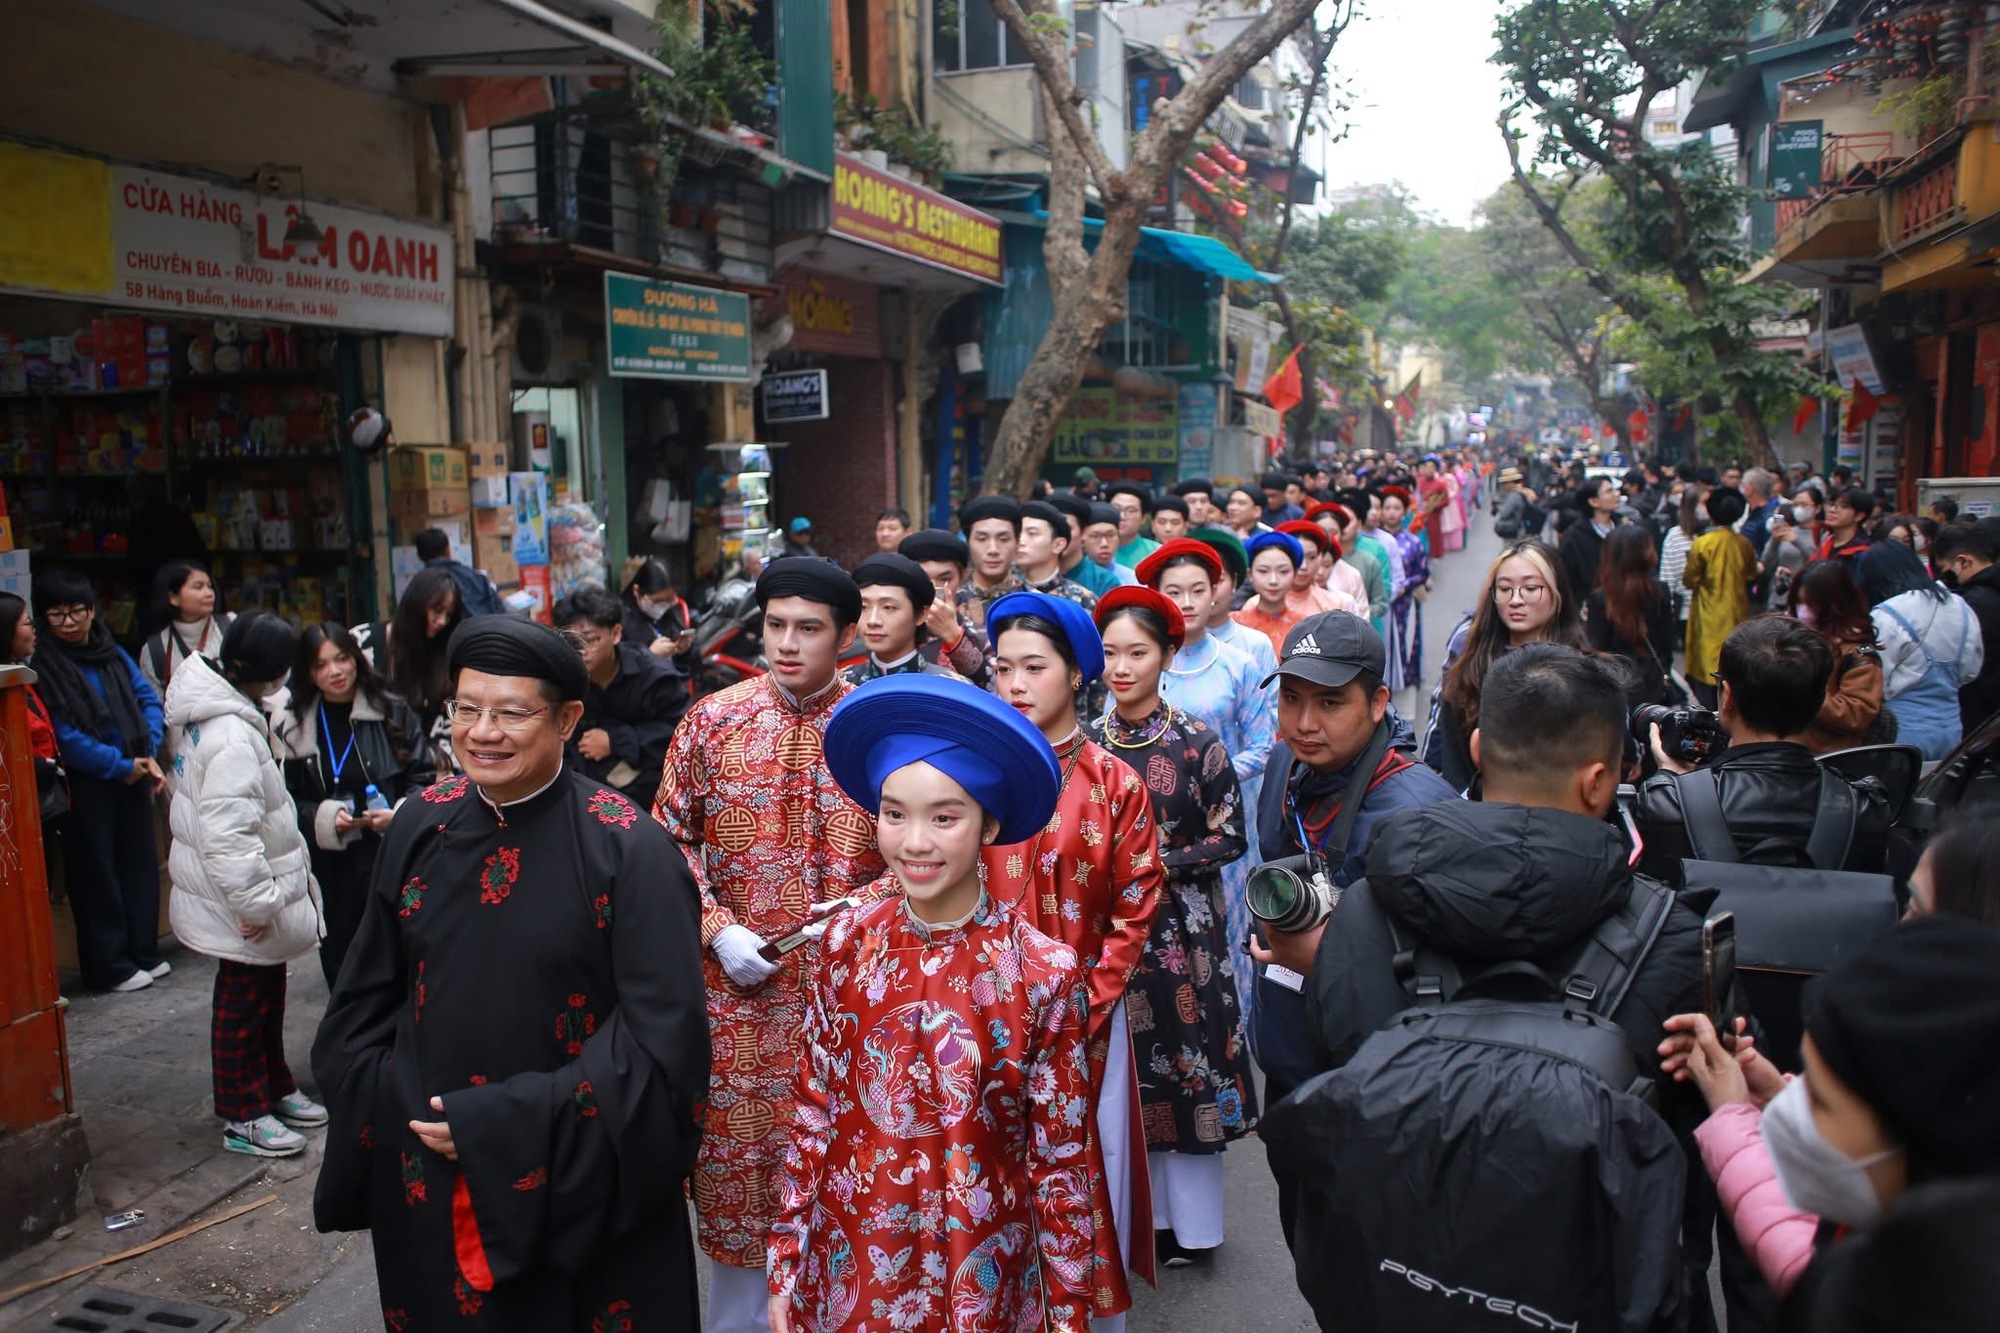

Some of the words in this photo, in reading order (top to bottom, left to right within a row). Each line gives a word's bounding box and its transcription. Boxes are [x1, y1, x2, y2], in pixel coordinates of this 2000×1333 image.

[124, 177, 173, 214] CỬA
[180, 189, 243, 229] HÀNG
[835, 164, 914, 228] HOANG'S
[917, 199, 1000, 259] RESTAURANT
[126, 250, 192, 275] CHUYÊN
[197, 259, 222, 279] BIA
[235, 264, 274, 285] RƯỢU
[348, 229, 438, 283] OANH
[125, 281, 143, 298] 58
[147, 284, 183, 306] Hàng
[1291, 645, 1321, 655] adidas
[1379, 1258, 1578, 1333] PGYTECH
